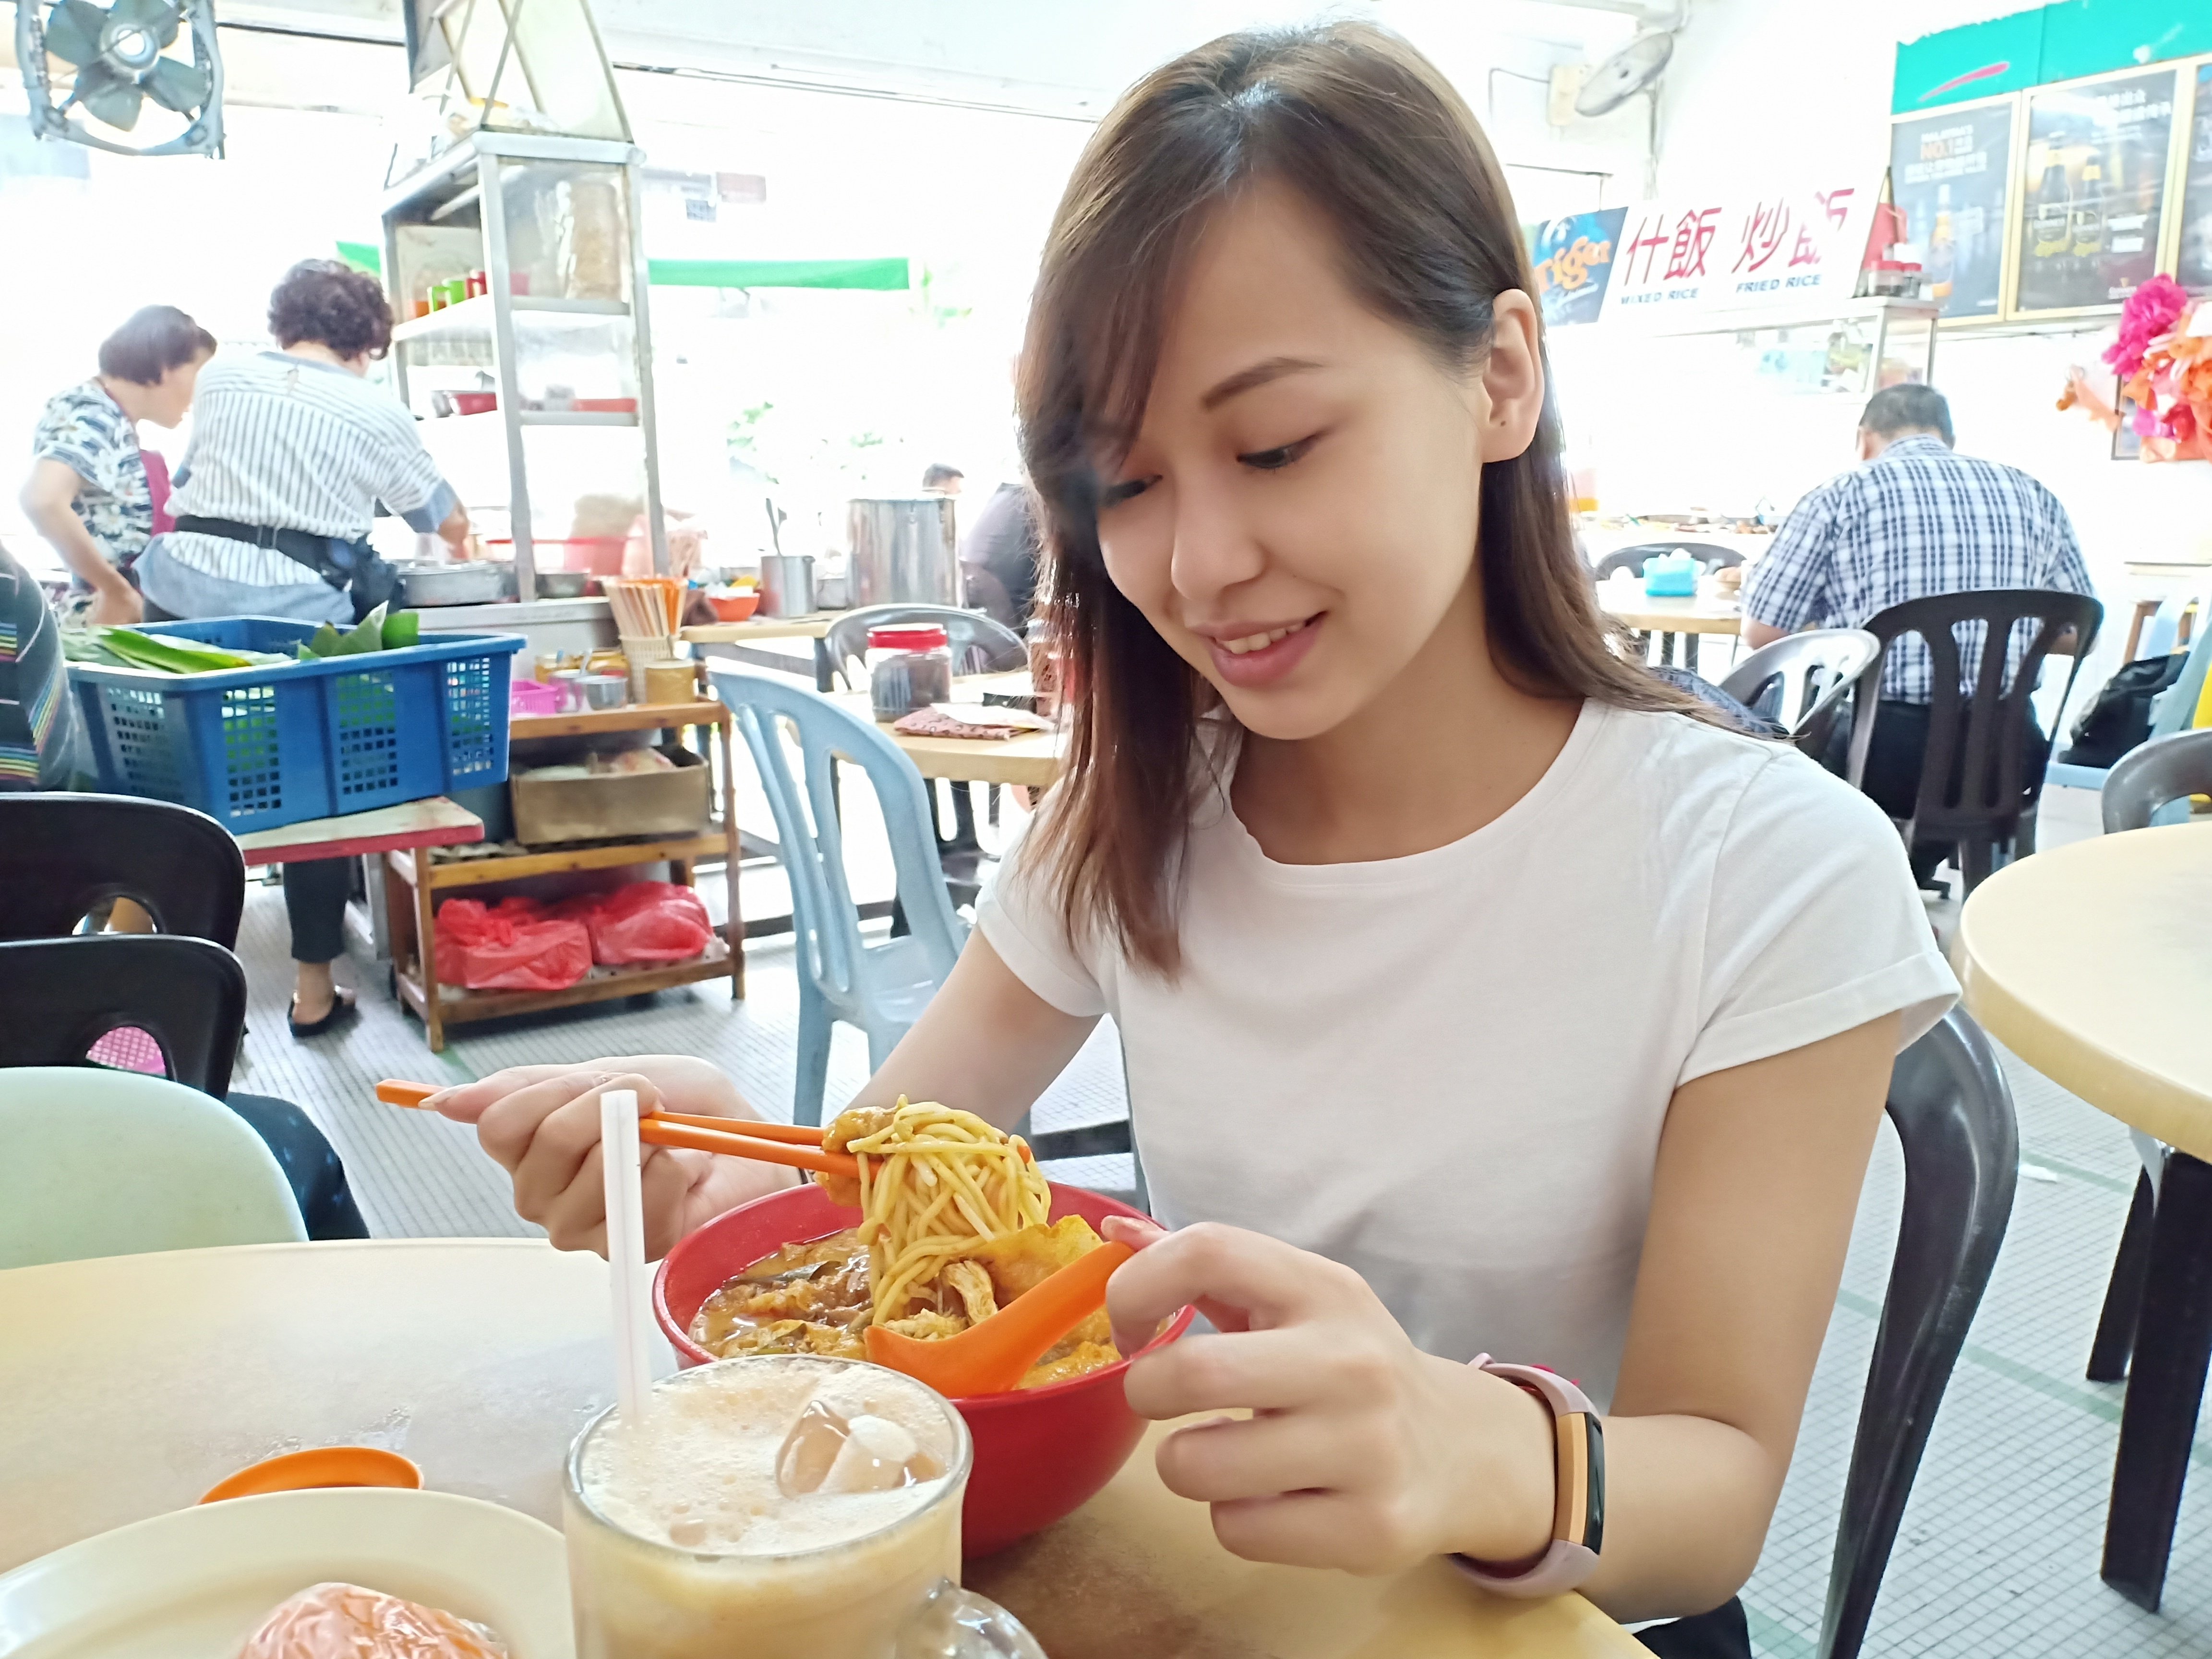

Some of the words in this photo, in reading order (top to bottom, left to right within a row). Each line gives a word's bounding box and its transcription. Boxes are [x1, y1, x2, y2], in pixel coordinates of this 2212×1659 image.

[1534, 236, 1611, 295] Tiger
[1624, 207, 1722, 286] 什飯
[1668, 288, 1698, 300] RICE
[1735, 279, 1779, 293] FRIED
[1785, 274, 1821, 288] RICE
